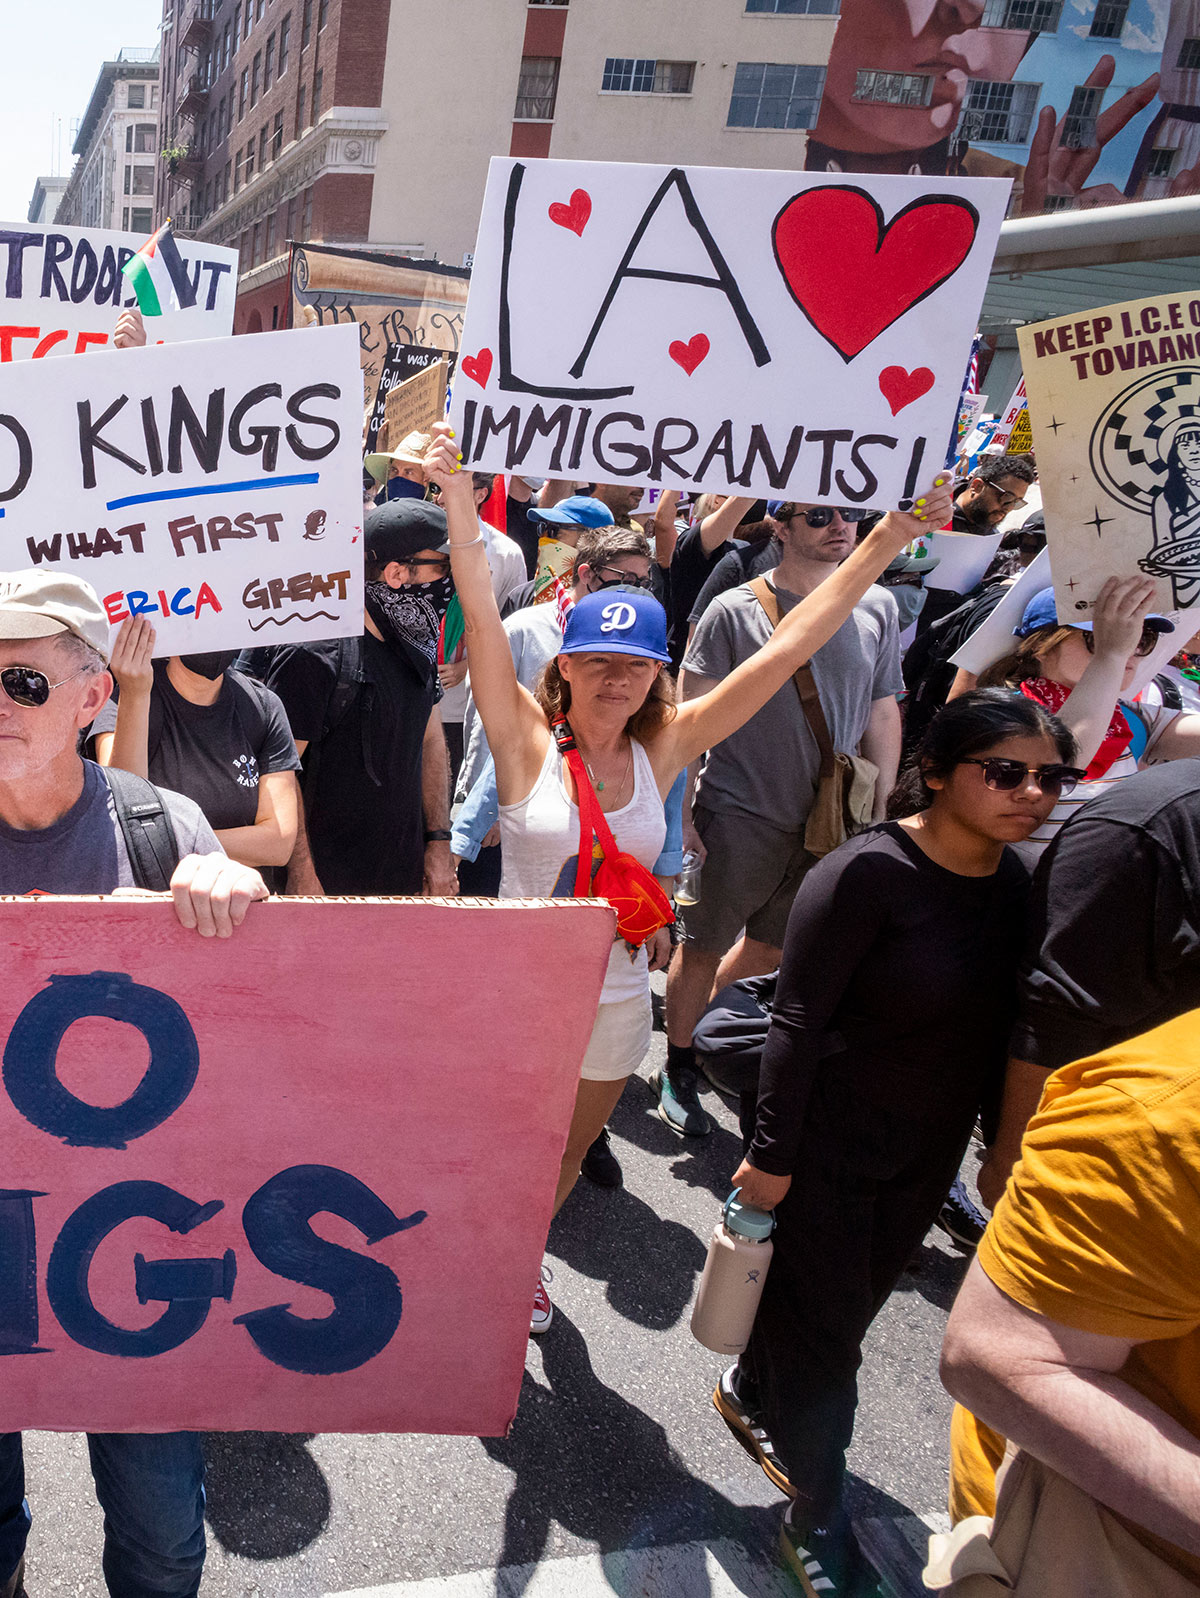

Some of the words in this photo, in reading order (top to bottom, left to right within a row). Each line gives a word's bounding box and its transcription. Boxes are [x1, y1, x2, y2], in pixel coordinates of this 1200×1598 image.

[499, 162, 772, 400] LA
[1033, 316, 1113, 359] KEEP
[1120, 303, 1184, 339] I.C.E
[1070, 333, 1200, 381] TOVAAN
[407, 353, 428, 367] was
[76, 381, 342, 489] KINGS
[461, 399, 927, 511] IMMIGRANTS!
[26, 523, 148, 565] WHAT
[168, 512, 284, 558] FIRST
[103, 581, 224, 626] ERICA
[242, 570, 351, 613] GREAT
[600, 602, 637, 633] D
